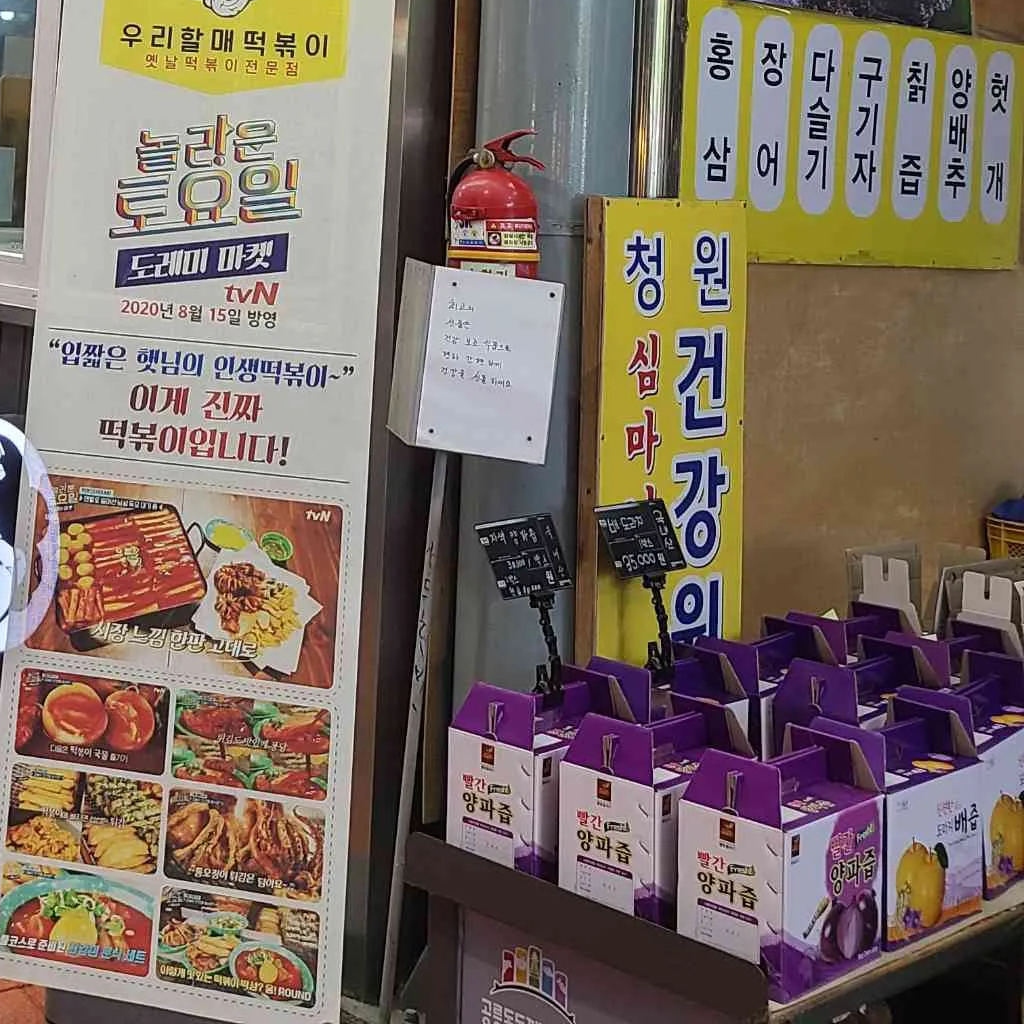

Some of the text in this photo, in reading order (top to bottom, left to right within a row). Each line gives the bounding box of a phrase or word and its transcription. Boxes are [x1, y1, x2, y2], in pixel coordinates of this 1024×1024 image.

[120, 23, 329, 58] 우리할매떡볶이
[144, 54, 300, 78] 옛날떡볶이전문점
[703, 32, 734, 183] 홍삼
[756, 41, 787, 186] 장어
[804, 48, 835, 190] 다슬기
[851, 56, 884, 193] 구기자
[135, 114, 278, 173] 놀라운
[898, 60, 929, 196] 칡즙
[943, 68, 973, 199] 양배추
[986, 72, 1009, 202] 헛개
[109, 158, 303, 239] 토요일
[127, 239, 275, 282] 도레미 마켓
[224, 281, 280, 306] tvN
[120, 299, 278, 329] 2020년 8월 15일 방영
[136, 346, 204, 378] 햇님의
[130, 383, 263, 423] 이게 진짜
[627, 333, 661, 500] 심마
[99, 418, 291, 467] 떡볶이입니다!
[304, 508, 332, 524] tvN
[93, 623, 129, 644] 시장
[128, 626, 167, 649] 느낌
[70, 745, 92, 759] 떡볶이
[93, 749, 109, 762] 국물
[462, 774, 488, 793] 빨간
[462, 792, 513, 826] 양파즙
[576, 807, 603, 832] 빨간
[954, 803, 980, 834] 배즙
[576, 828, 633, 866] 양파즙
[697, 850, 726, 873] 빨간
[697, 870, 759, 911] 양파즙
[830, 848, 877, 896] 양파즙
[278, 987, 312, 1002] ROUND
